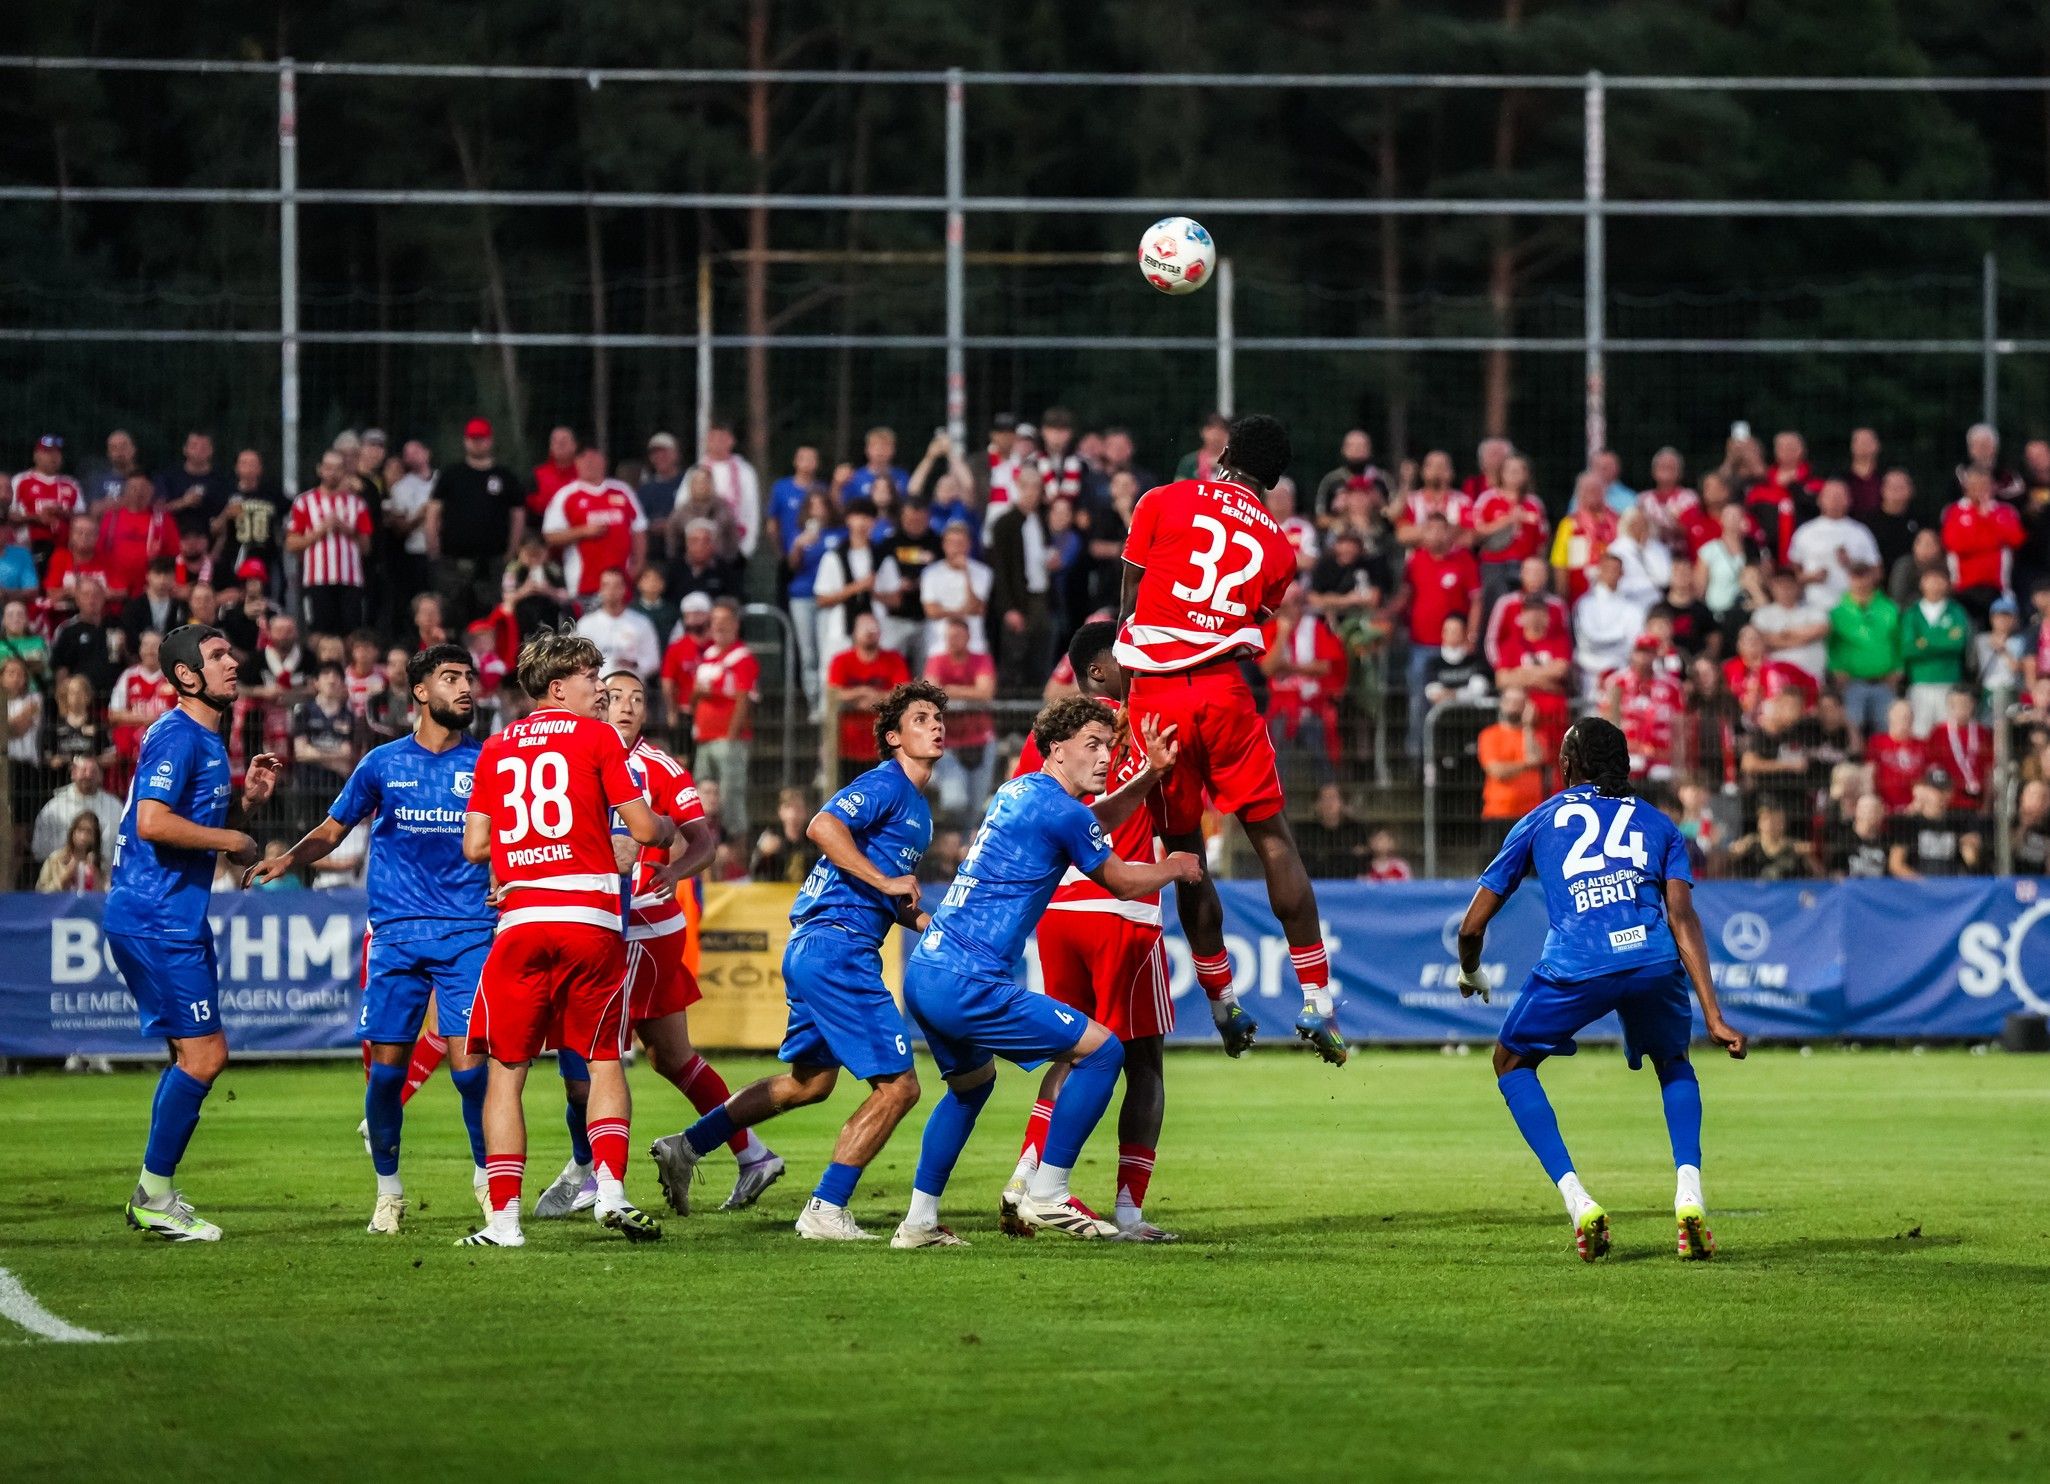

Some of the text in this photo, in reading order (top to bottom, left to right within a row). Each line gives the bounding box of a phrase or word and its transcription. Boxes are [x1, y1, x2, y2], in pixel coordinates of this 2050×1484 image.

[1197, 484, 1208, 497] 1.
[1212, 489, 1232, 504] FC
[1237, 498, 1278, 534] UNION
[1220, 504, 1254, 527] BERLIN
[1171, 514, 1264, 617] 32
[1187, 610, 1225, 631] GRAY
[502, 720, 578, 741] 1. FC UNION
[518, 736, 548, 748] BERLIN
[387, 780, 418, 789] uhlsport
[496, 751, 573, 844] 38
[1553, 803, 1648, 881] 24
[507, 844, 573, 868] PROSCHE
[1567, 879, 1586, 896] VSG
[1574, 878, 1637, 914] BERLI
[1614, 929, 1642, 943] DDR
[189, 999, 211, 1022] 13
[1054, 1009, 1074, 1025] 4
[895, 1034, 906, 1055] 6
